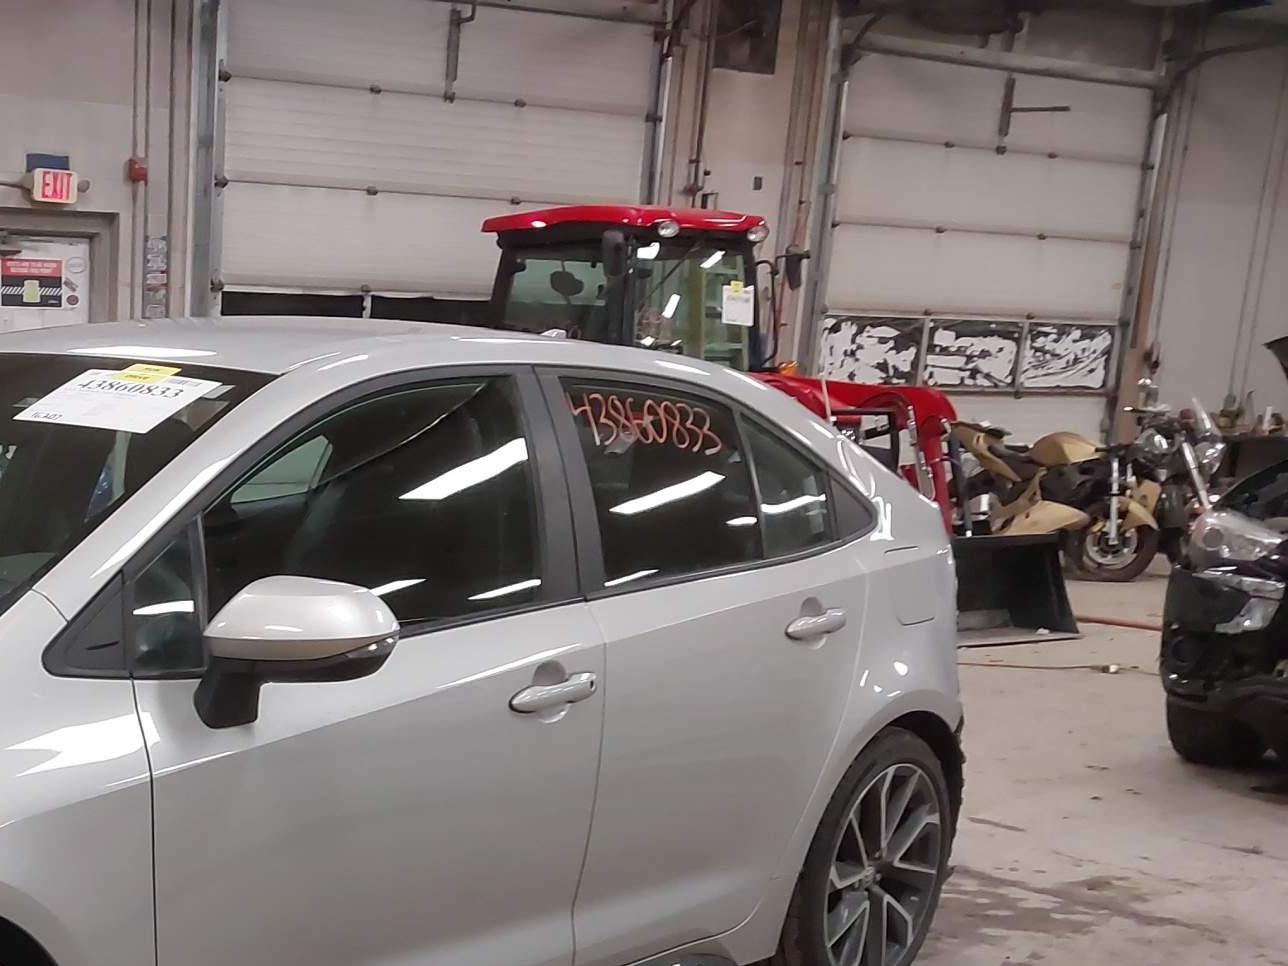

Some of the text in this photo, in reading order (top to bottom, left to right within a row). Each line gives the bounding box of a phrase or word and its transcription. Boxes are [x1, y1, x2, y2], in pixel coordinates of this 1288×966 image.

[41, 170, 73, 200] EXIT
[79, 378, 185, 400] 43860833
[566, 391, 722, 456] 43860833
